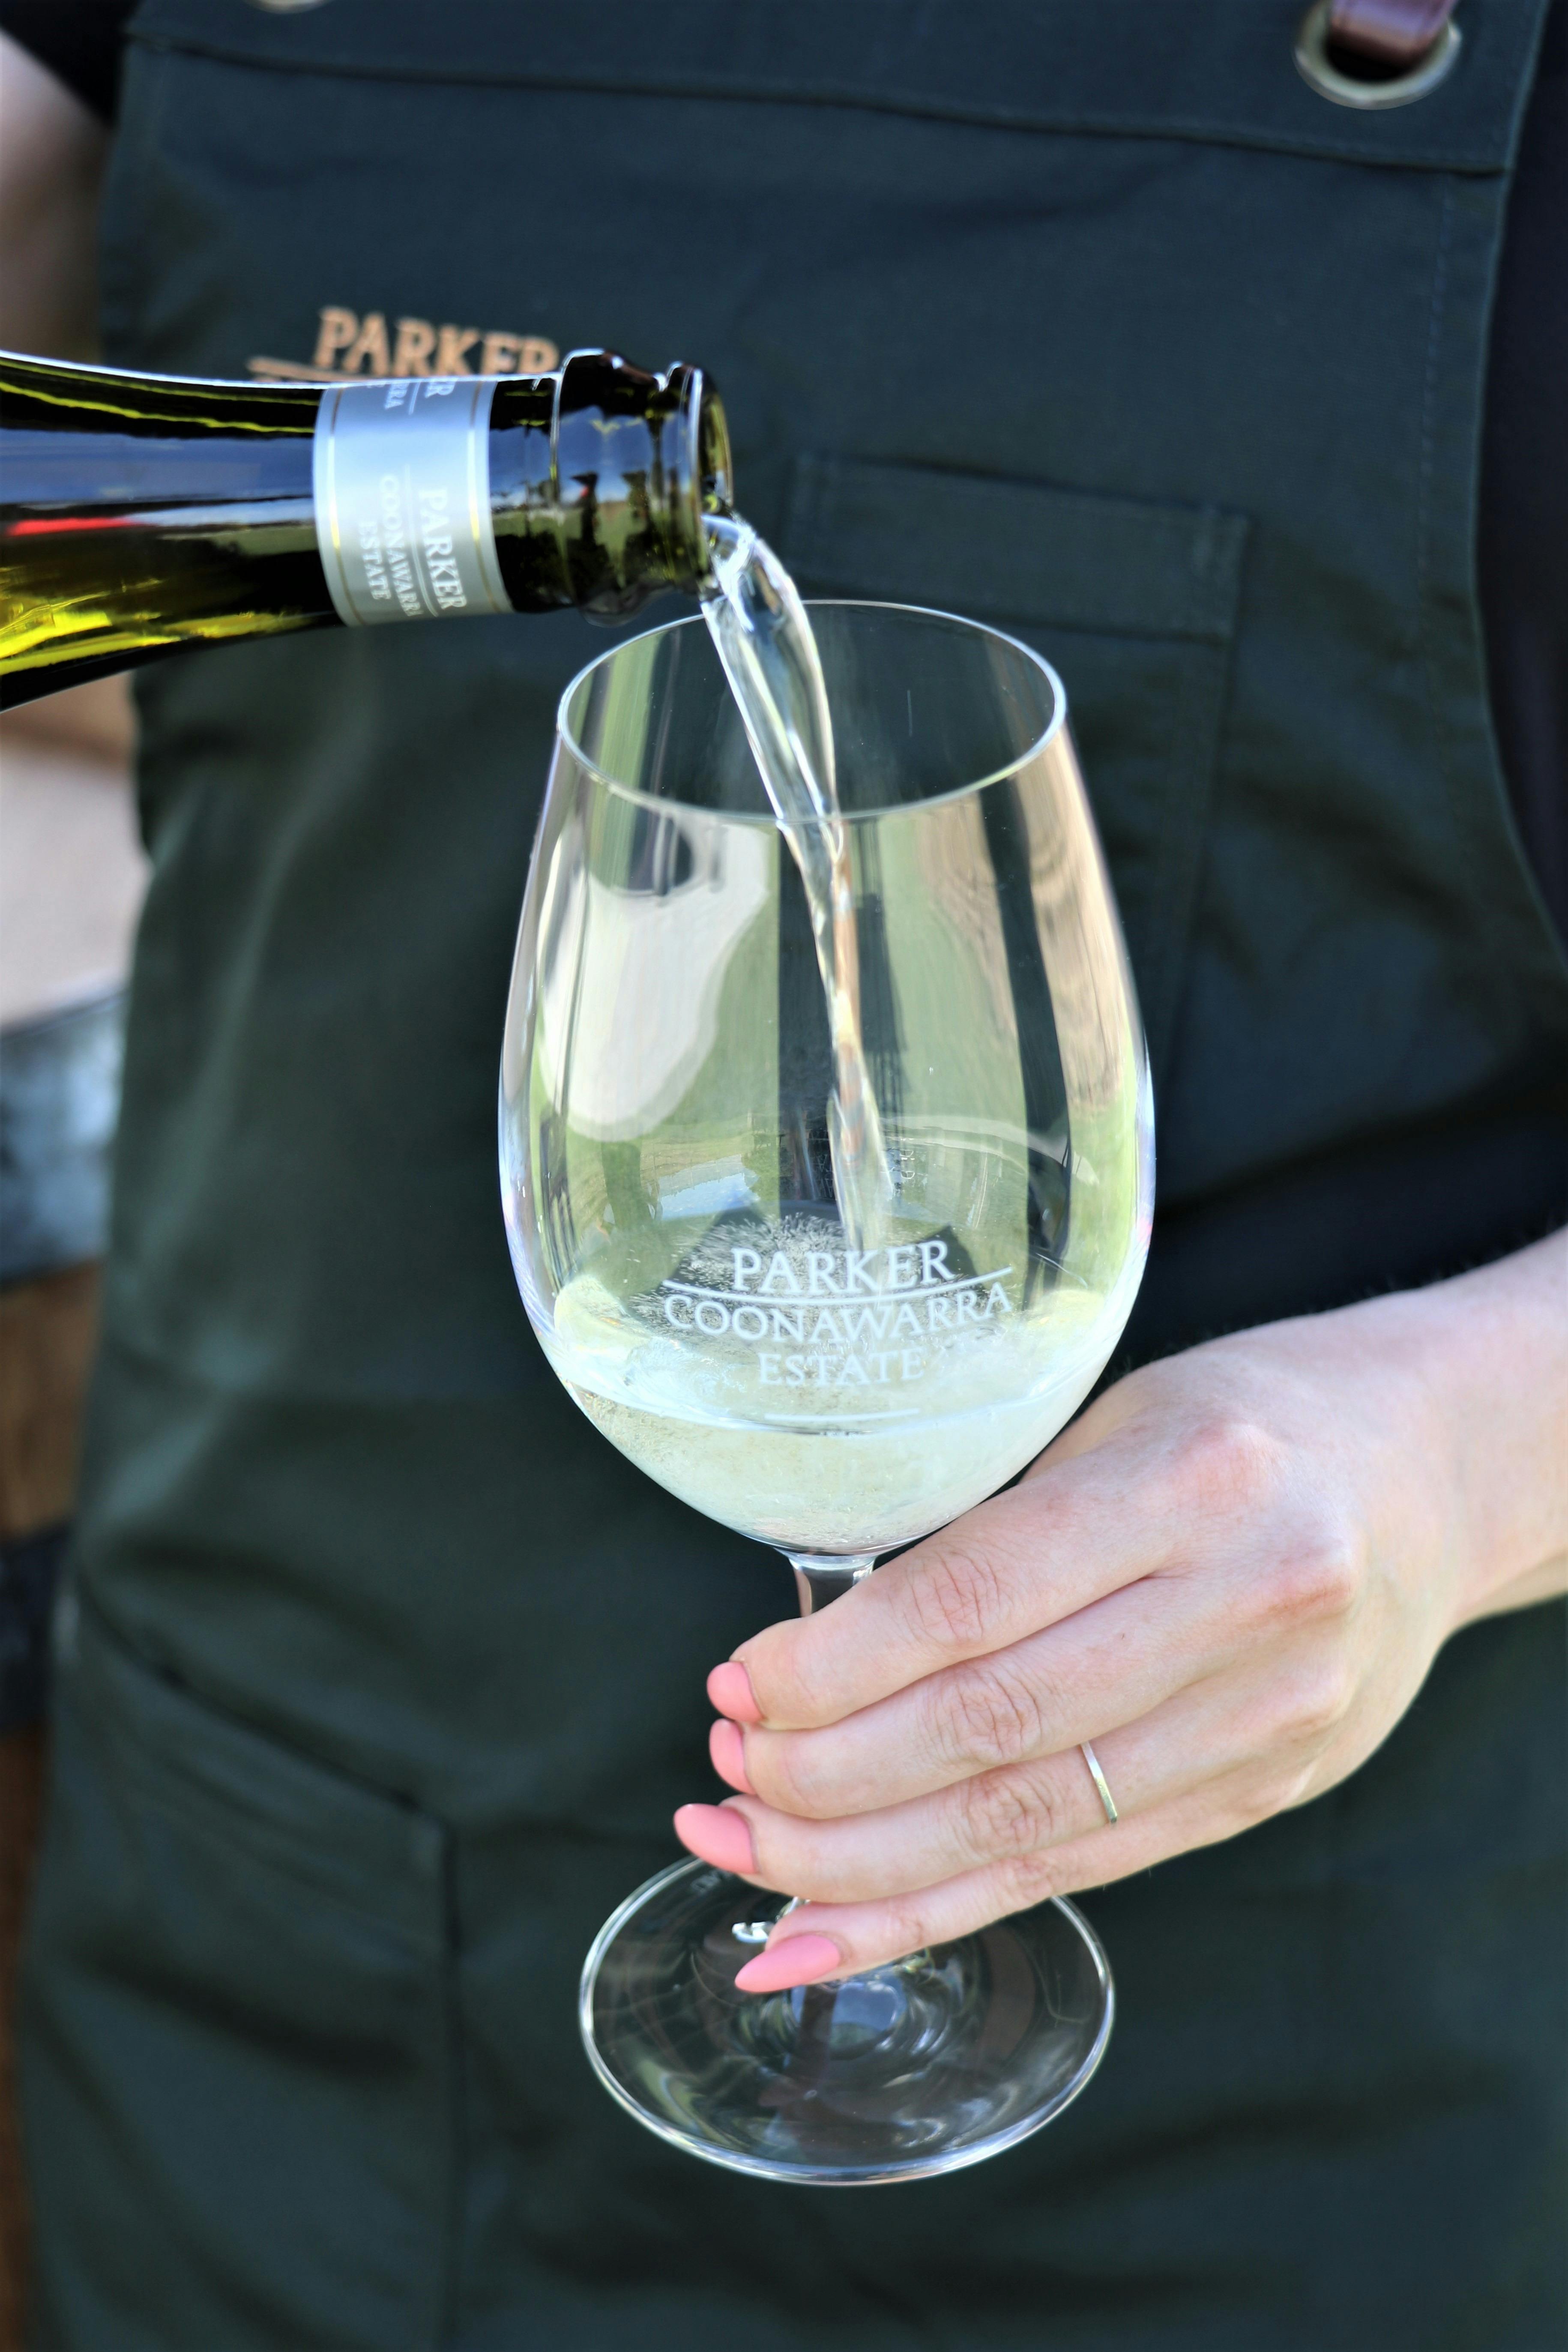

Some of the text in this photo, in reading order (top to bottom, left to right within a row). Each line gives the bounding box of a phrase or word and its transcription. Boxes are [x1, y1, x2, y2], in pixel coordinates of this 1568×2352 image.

[358, 520, 391, 600] ESTATE
[419, 488, 467, 610] PARKER
[731, 1240, 956, 1296] PARKER
[663, 1282, 1012, 1345] COONAWARRA
[758, 1347, 926, 1387] ESTATE
